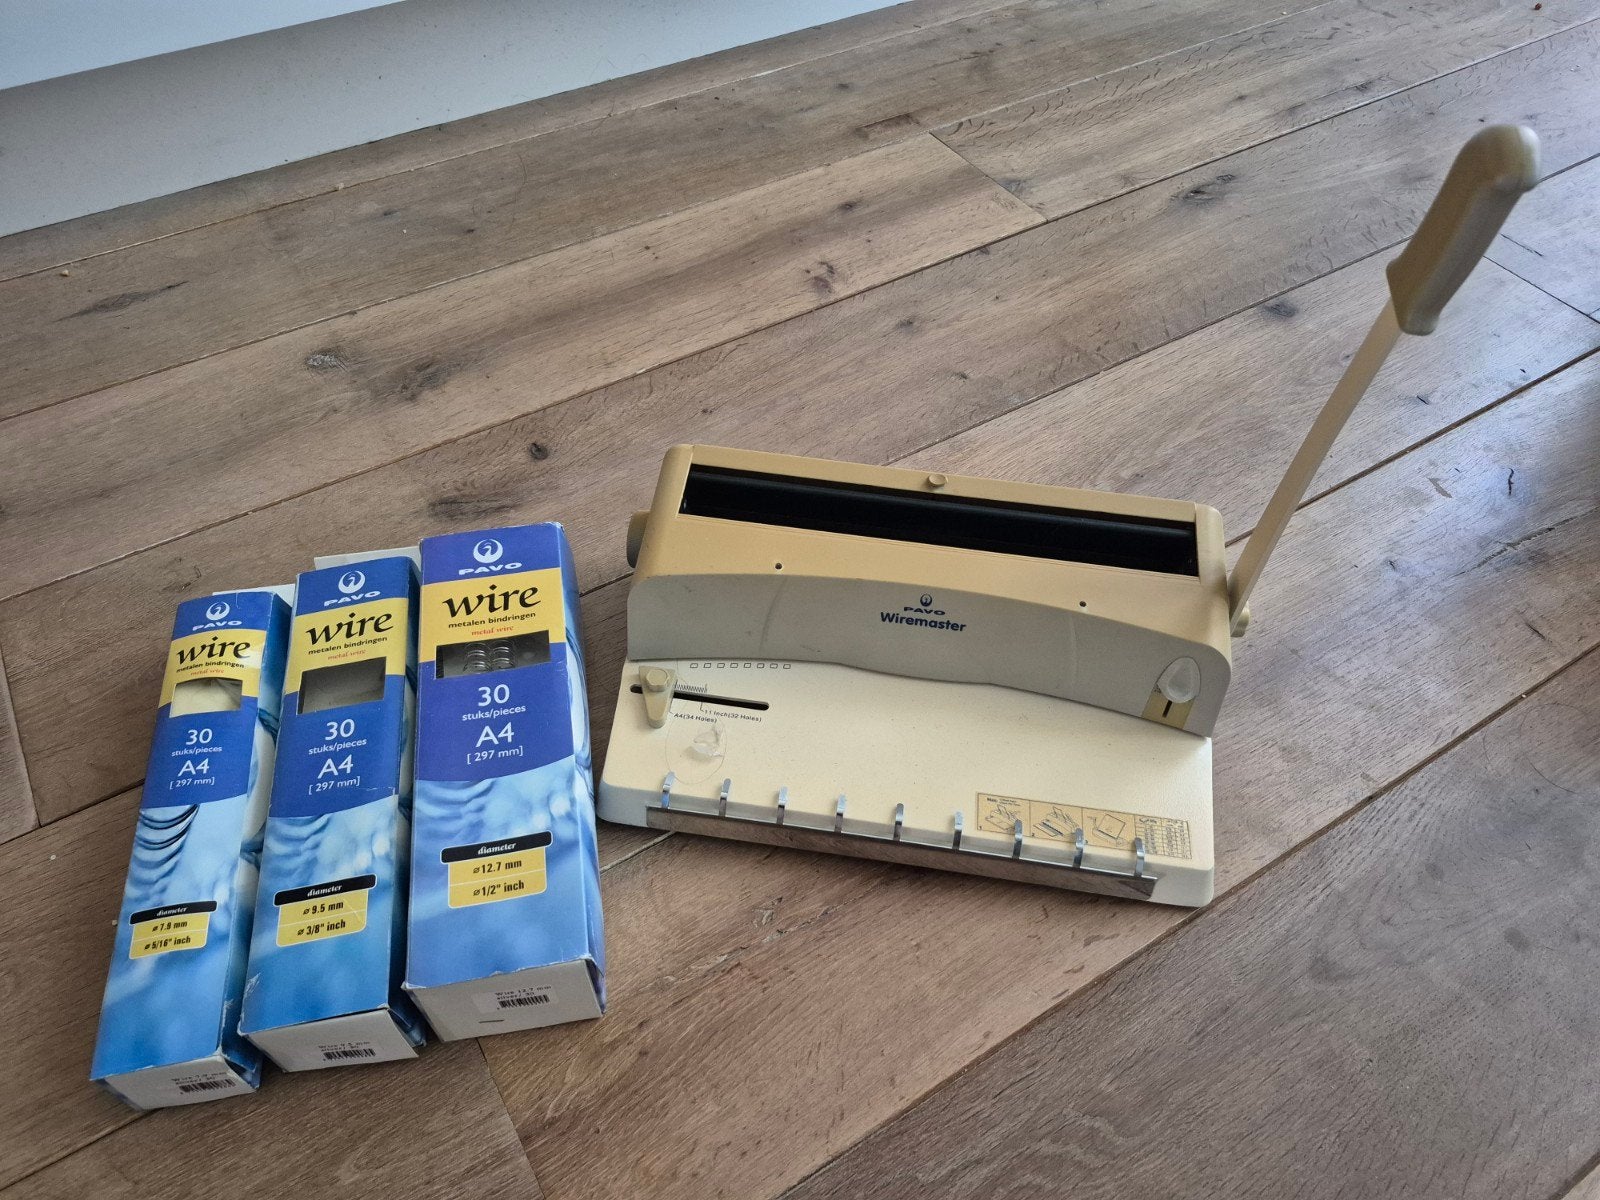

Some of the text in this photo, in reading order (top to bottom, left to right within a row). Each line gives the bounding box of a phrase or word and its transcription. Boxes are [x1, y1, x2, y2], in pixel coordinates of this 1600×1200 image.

[458, 562, 523, 576] PAVO
[324, 590, 381, 607] PAVO
[442, 584, 542, 618] wire
[903, 606, 946, 616] PAVO
[192, 620, 242, 631] PAVO
[448, 612, 536, 629] metalen bindringen
[880, 611, 967, 632] Wiremaster
[305, 612, 394, 646] wire
[471, 624, 514, 636] metal wire
[176, 636, 251, 665] wire
[308, 636, 388, 655] metalen bindringen
[328, 649, 366, 660] metal wire
[176, 660, 245, 673] metalen bindringen
[190, 668, 208, 676] metal
[478, 683, 510, 707] 30
[462, 705, 527, 722] stuks/pieces
[324, 718, 355, 740] 30
[475, 722, 515, 748] A4
[185, 728, 213, 745] 30
[171, 746, 223, 757] stuks/pieces
[308, 738, 367, 755] stuks/pieces
[178, 758, 210, 777] A4
[317, 754, 354, 779] A4
[477, 842, 517, 855] diameter
[505, 860, 522, 870] mm
[307, 885, 343, 897] diameter
[503, 880, 525, 893] inch
[156, 906, 188, 917] diameter
[328, 901, 344, 911] mm
[173, 920, 188, 929] mm
[326, 919, 346, 931] inch
[173, 936, 191, 946] inch
